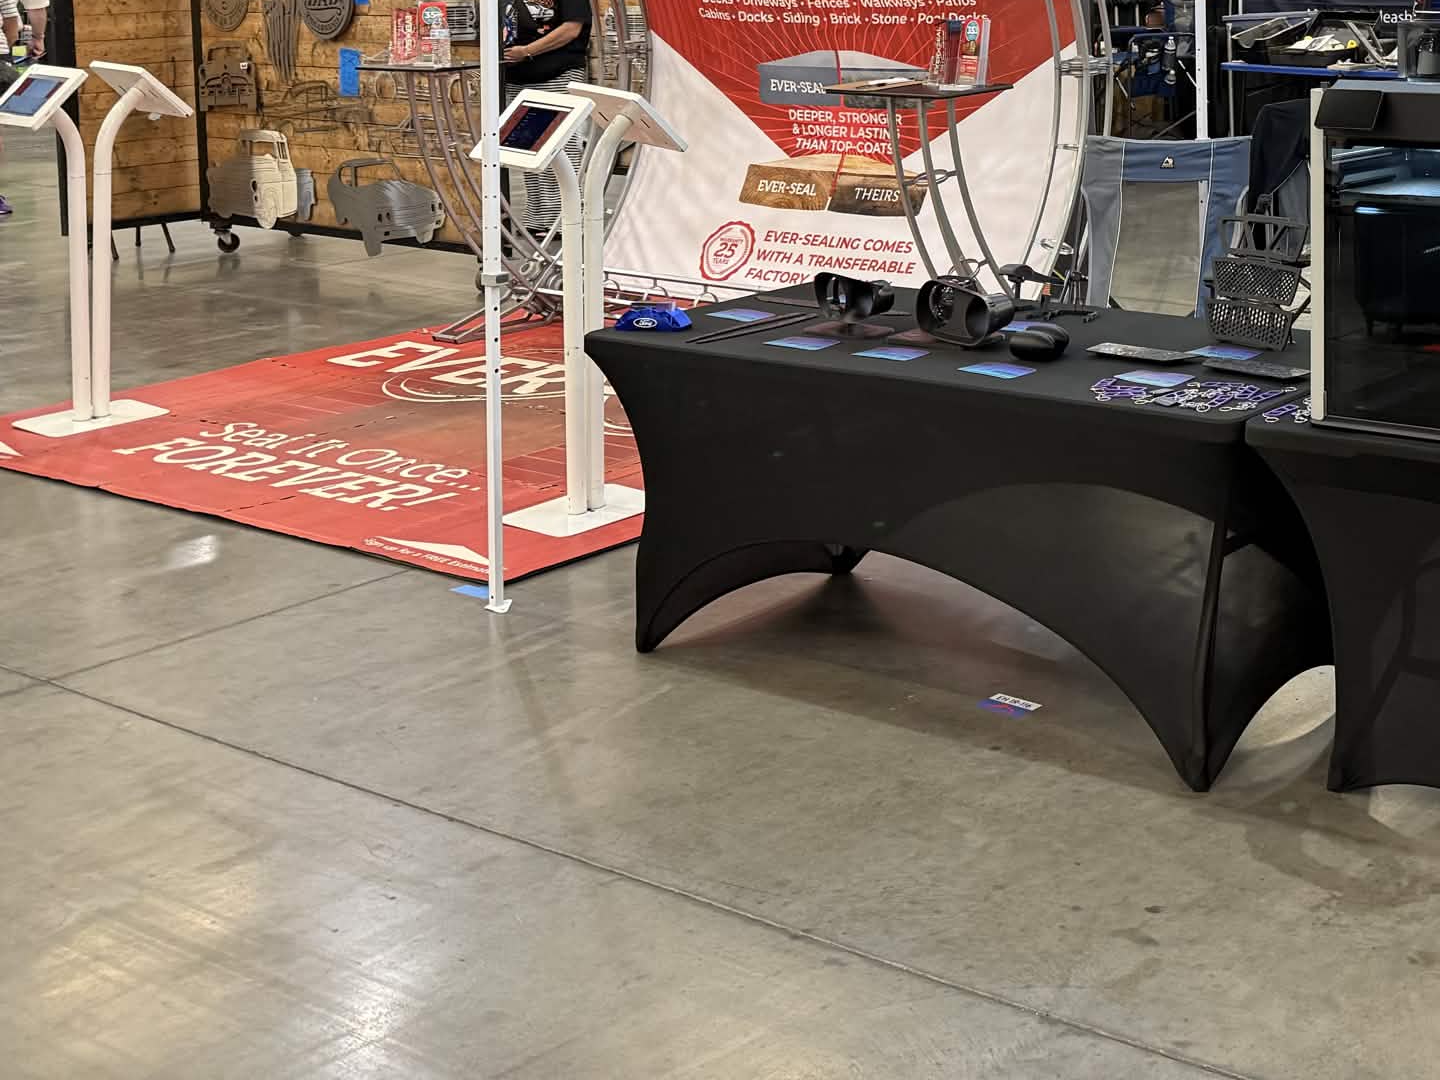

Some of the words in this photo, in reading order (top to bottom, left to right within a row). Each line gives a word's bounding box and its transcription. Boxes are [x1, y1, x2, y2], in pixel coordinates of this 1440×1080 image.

[698, 7, 731, 21] Cabins
[737, 10, 775, 23] Docks
[782, 11, 821, 27] Siding
[829, 11, 862, 25] Brick
[871, 12, 908, 25] Stone
[770, 79, 826, 94] EVER-SEAL
[788, 109, 836, 124] DEEPER,
[838, 111, 902, 125] STRONGR
[792, 124, 801, 135] &
[801, 124, 847, 137] LONGER
[795, 138, 828, 151] THAN
[831, 140, 893, 154] TOP-COATS
[757, 180, 816, 196] EVER-SEAL
[854, 187, 900, 202] THEIRS
[713, 242, 738, 258] 25
[763, 230, 860, 250] EVER-SEALING
[863, 239, 913, 254] COMES
[756, 248, 793, 264] WITH
[793, 256, 804, 265] A
[807, 254, 916, 274] TRANSFERABLE
[744, 267, 810, 285] FACTORY
[200, 422, 304, 449] Seal
[285, 433, 350, 458] it
[112, 436, 462, 512] FOREVER!
